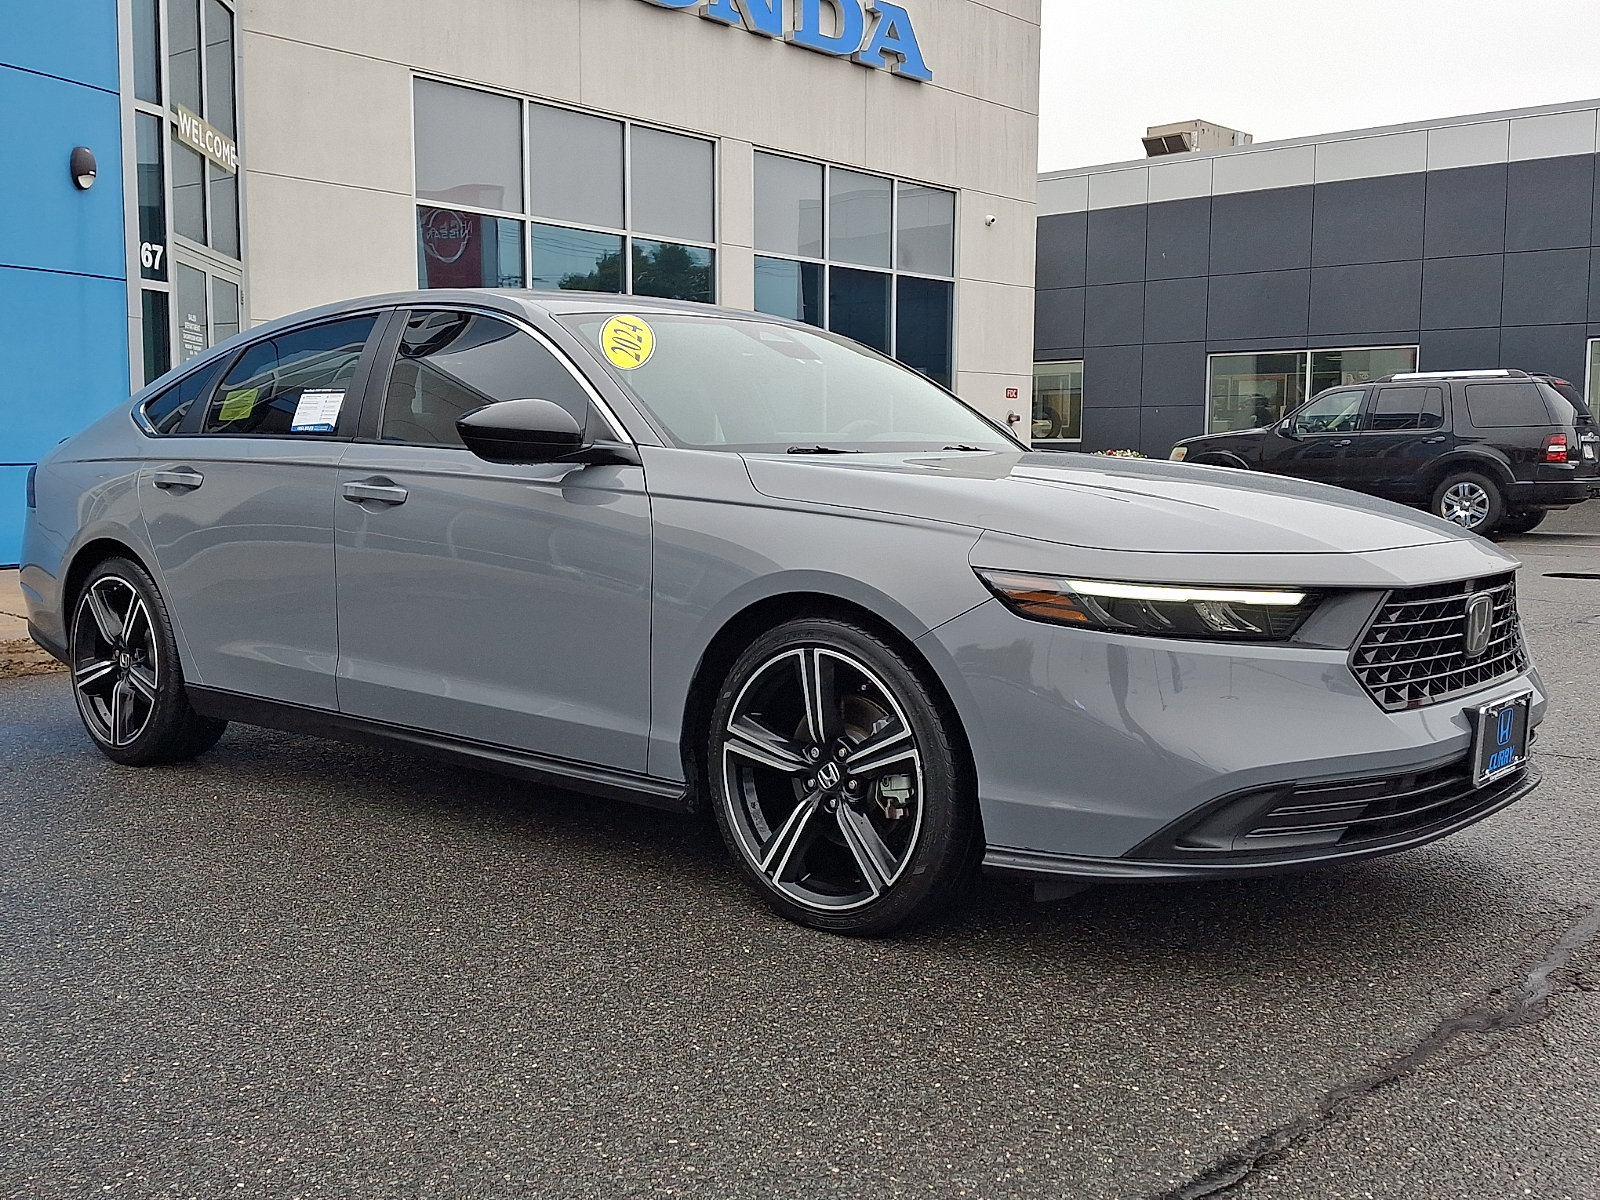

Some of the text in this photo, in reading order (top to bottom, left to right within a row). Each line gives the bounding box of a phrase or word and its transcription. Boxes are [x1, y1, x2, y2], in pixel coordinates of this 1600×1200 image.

[638, 0, 932, 81] DA
[178, 109, 237, 169] WELCOME
[141, 242, 164, 270] 67
[611, 319, 643, 362] 2024
[1006, 389, 1018, 398] FDC
[1489, 745, 1515, 771] CURRY
